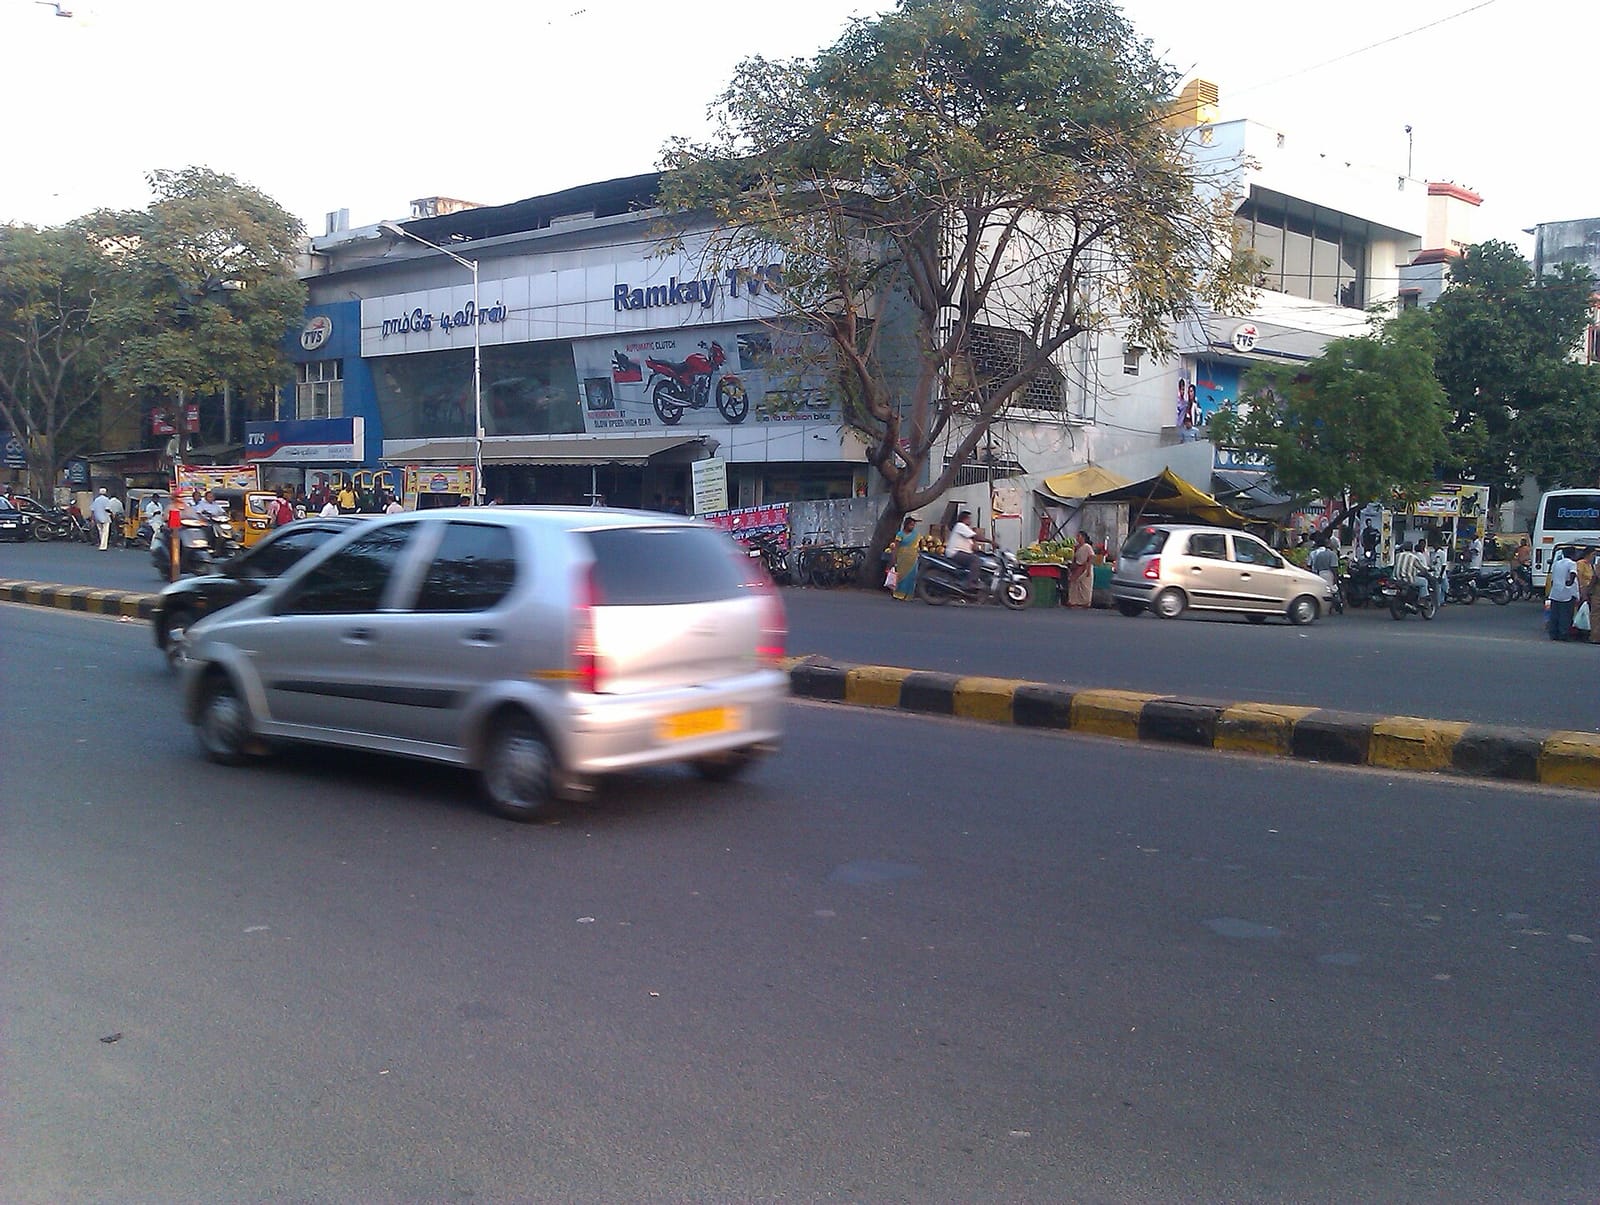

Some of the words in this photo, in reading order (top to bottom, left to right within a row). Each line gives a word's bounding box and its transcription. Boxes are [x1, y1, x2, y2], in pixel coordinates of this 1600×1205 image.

[613, 276, 717, 312] Ramkay
[305, 330, 324, 345] TVS
[1236, 333, 1255, 347] TVS
[248, 432, 265, 445] TVS
